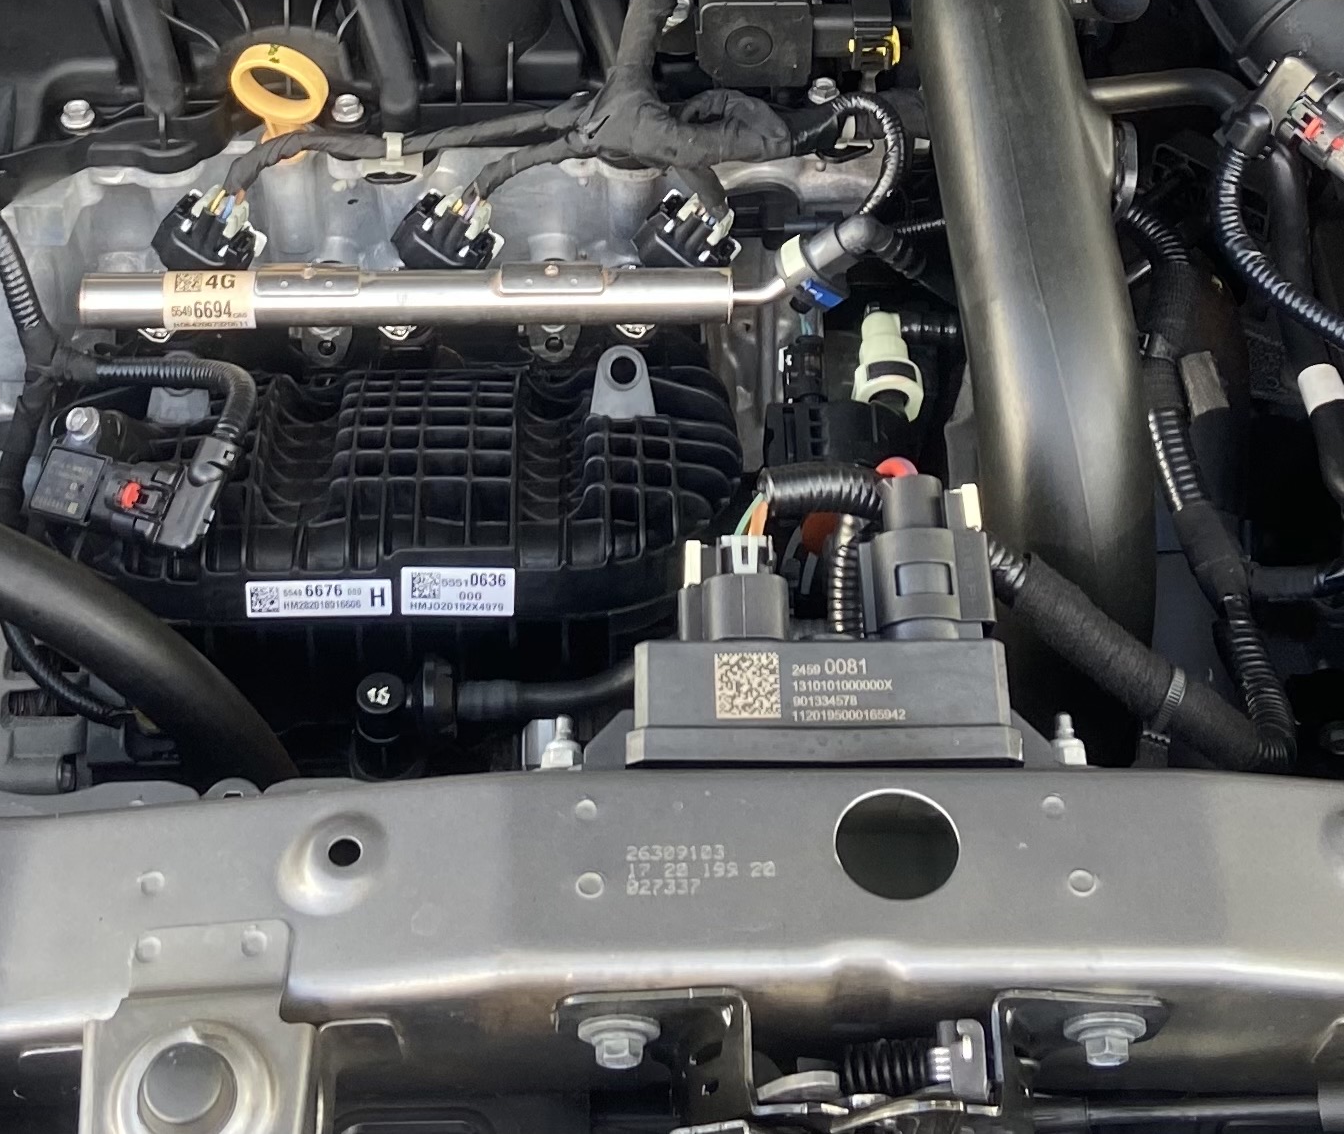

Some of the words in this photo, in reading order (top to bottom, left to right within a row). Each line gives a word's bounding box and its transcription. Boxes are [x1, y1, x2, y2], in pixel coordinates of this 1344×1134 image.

[205, 273, 236, 289] 4G
[369, 587, 386, 607] H
[824, 657, 867, 675] 0081
